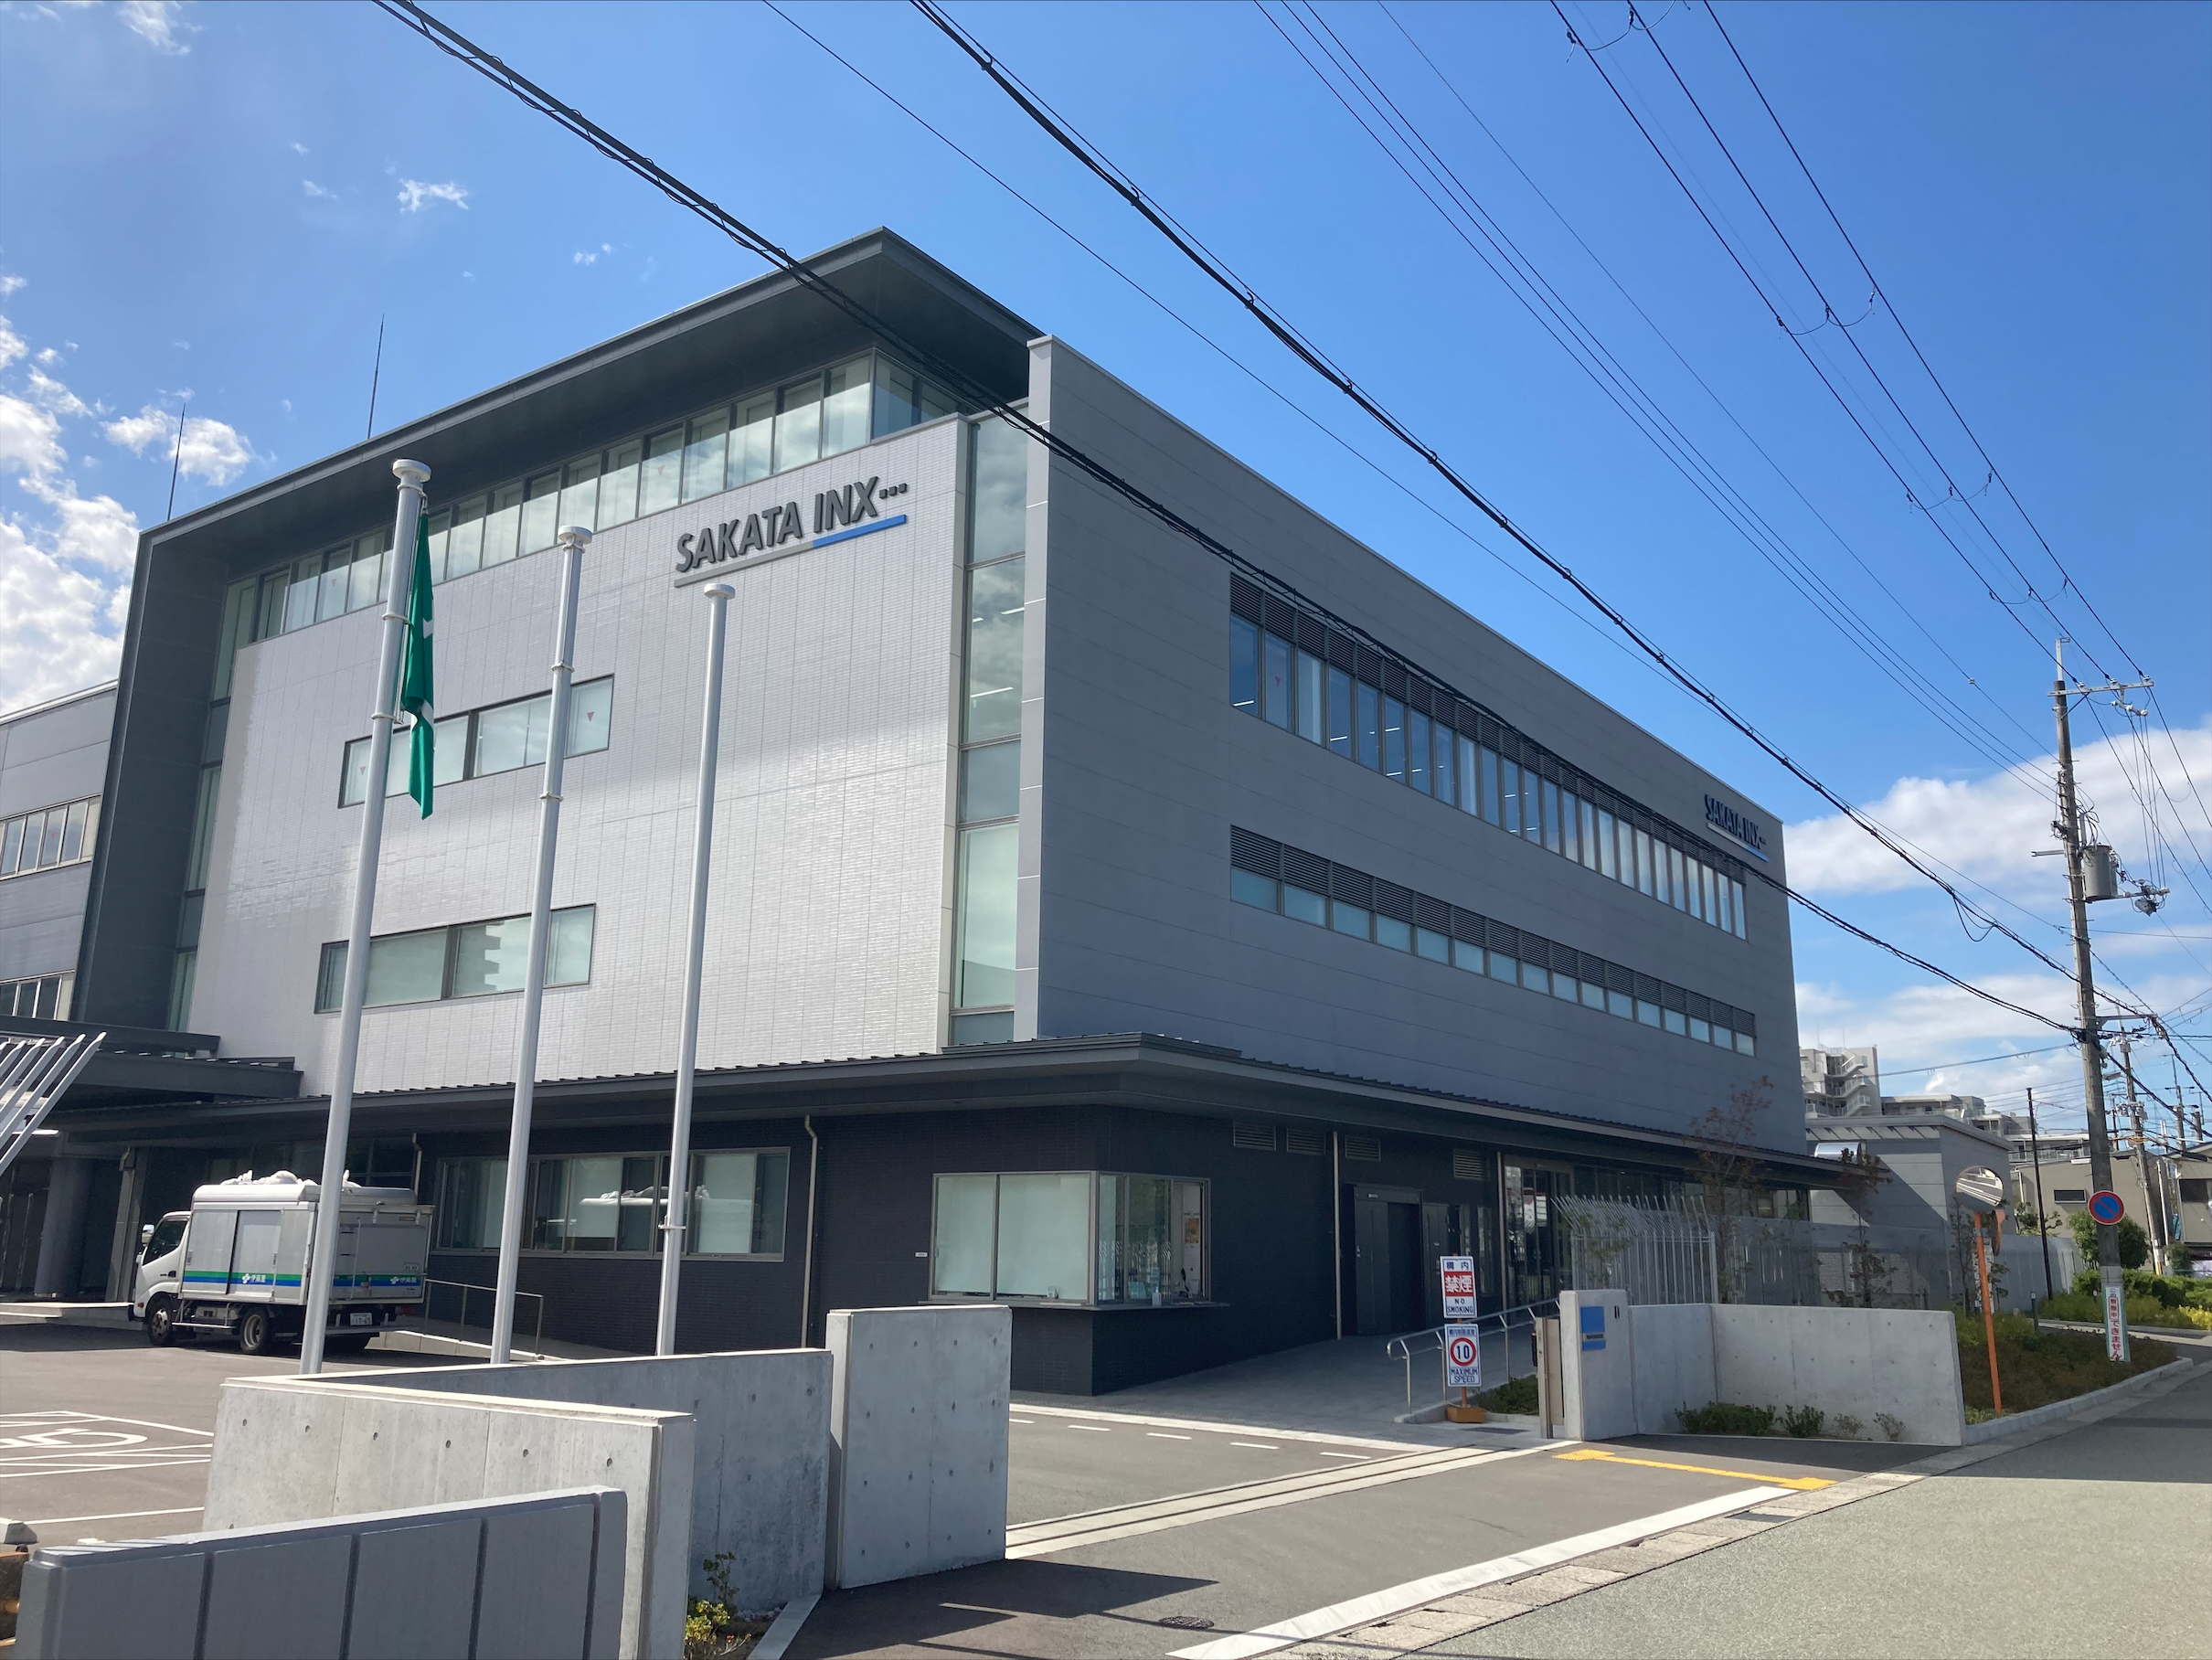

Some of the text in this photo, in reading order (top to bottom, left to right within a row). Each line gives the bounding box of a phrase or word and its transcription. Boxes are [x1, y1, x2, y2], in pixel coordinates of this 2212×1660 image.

[675, 476, 878, 572] SAKATA INX
[1705, 794, 1744, 839] SAKATA
[1444, 1274, 1473, 1293] 禁煙
[1456, 1345, 1470, 1359] 10
